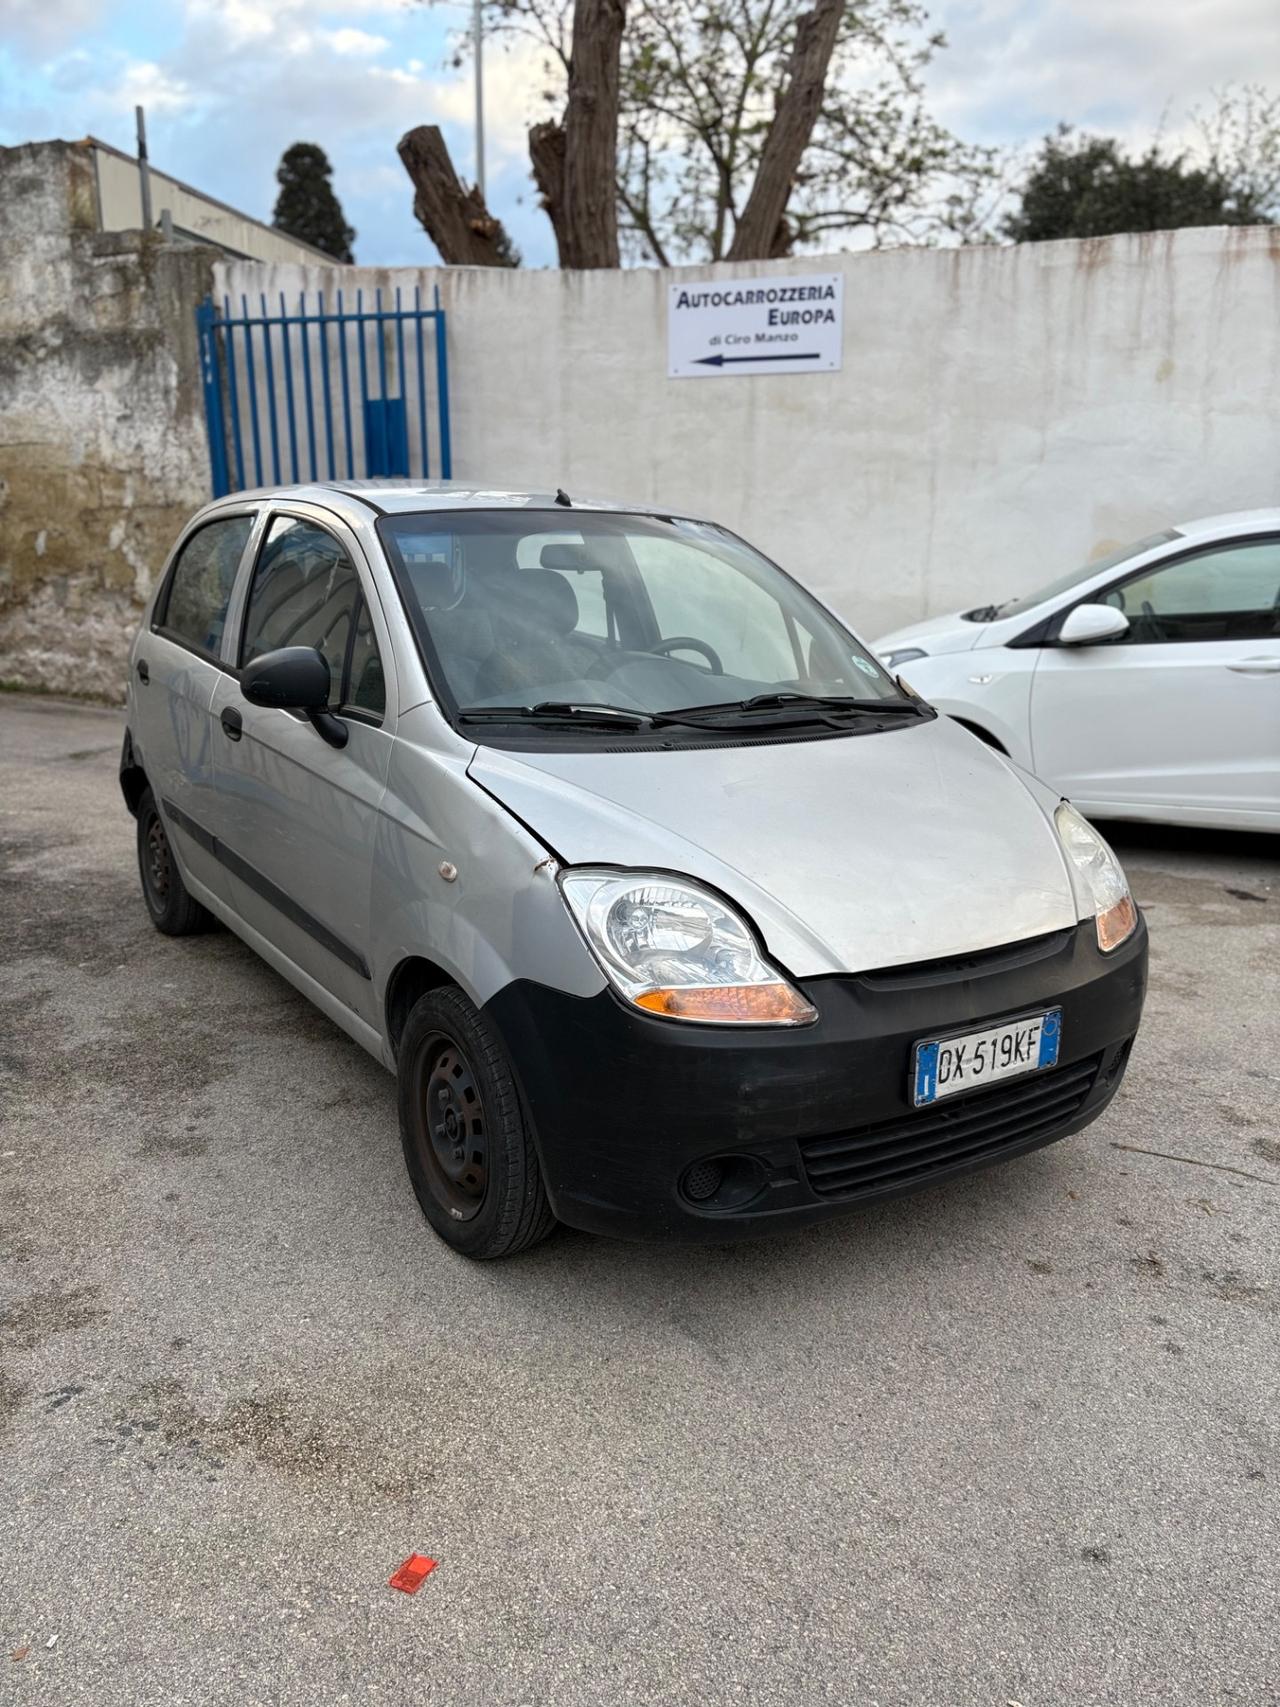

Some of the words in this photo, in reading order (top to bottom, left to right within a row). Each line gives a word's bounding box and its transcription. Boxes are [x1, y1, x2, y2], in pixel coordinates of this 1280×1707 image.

[677, 285, 835, 309] AUTOCARROZZERIA
[768, 308, 835, 326] EUROPA
[709, 334, 721, 346] di
[725, 333, 751, 345] Ciro
[754, 331, 799, 343] Manzo
